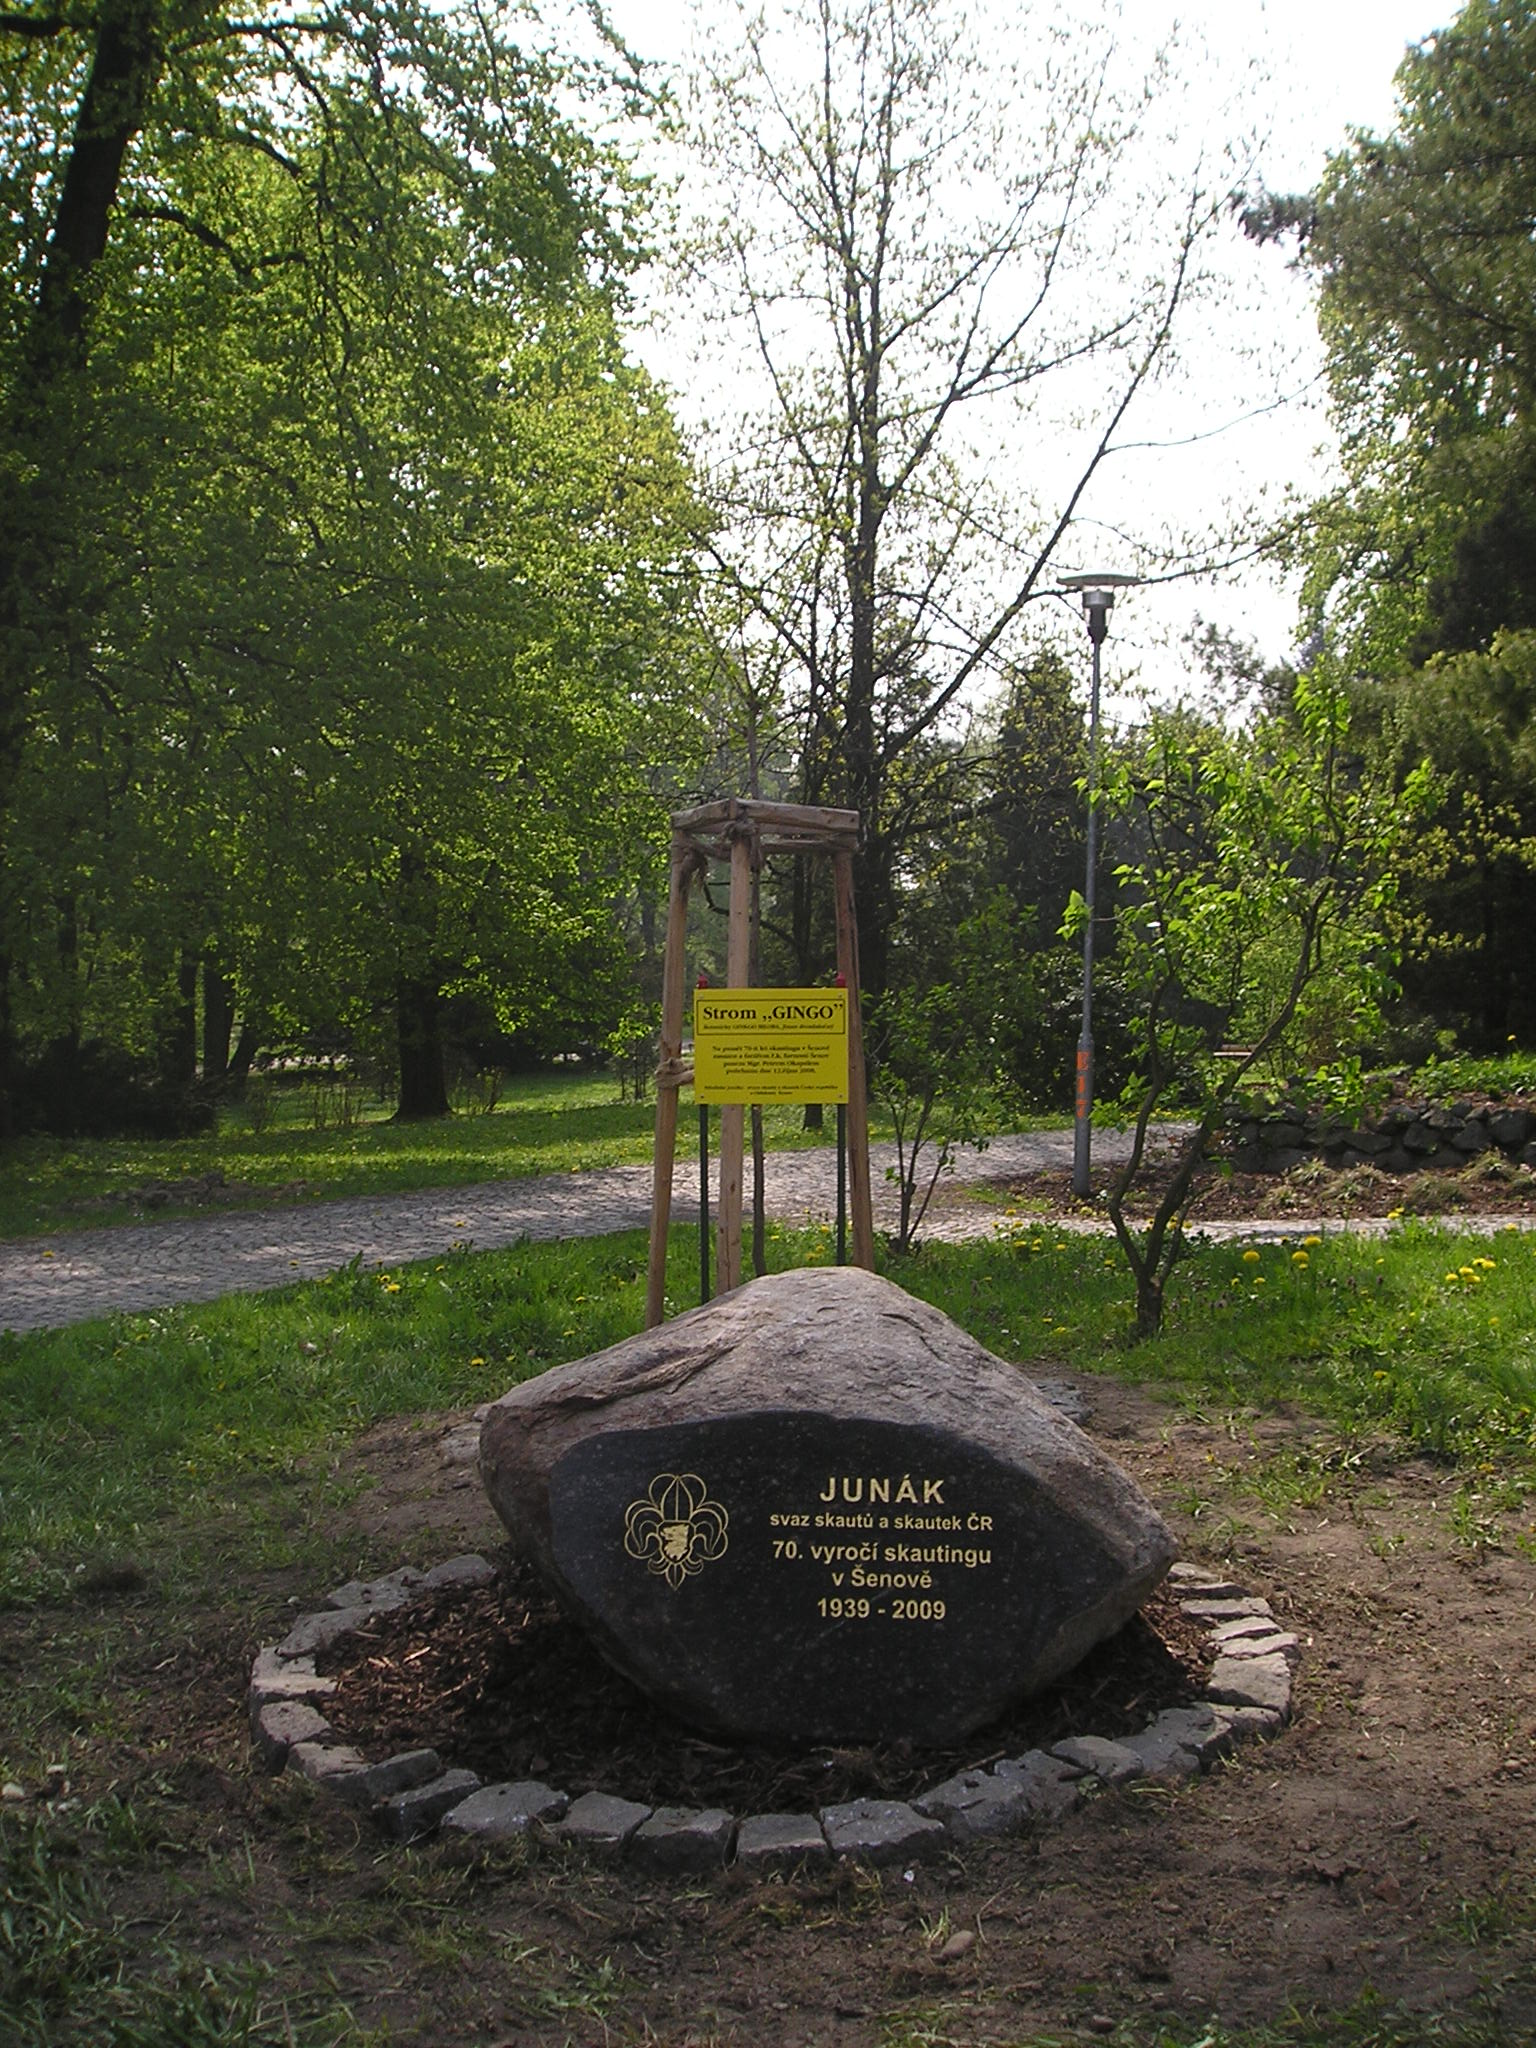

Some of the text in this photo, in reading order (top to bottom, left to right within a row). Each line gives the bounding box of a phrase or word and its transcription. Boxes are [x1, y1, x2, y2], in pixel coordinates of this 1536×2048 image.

[703, 1006, 757, 1020] Strom
[819, 1474, 945, 1504] JUNÁK
[770, 1512, 993, 1531] svaz skautů a skautek ČR
[772, 1540, 803, 1560] 70.
[884, 1543, 992, 1568] skautingu
[832, 1564, 933, 1589] v Šenově
[817, 1598, 870, 1618] 1939
[892, 1600, 946, 1620] 2009
